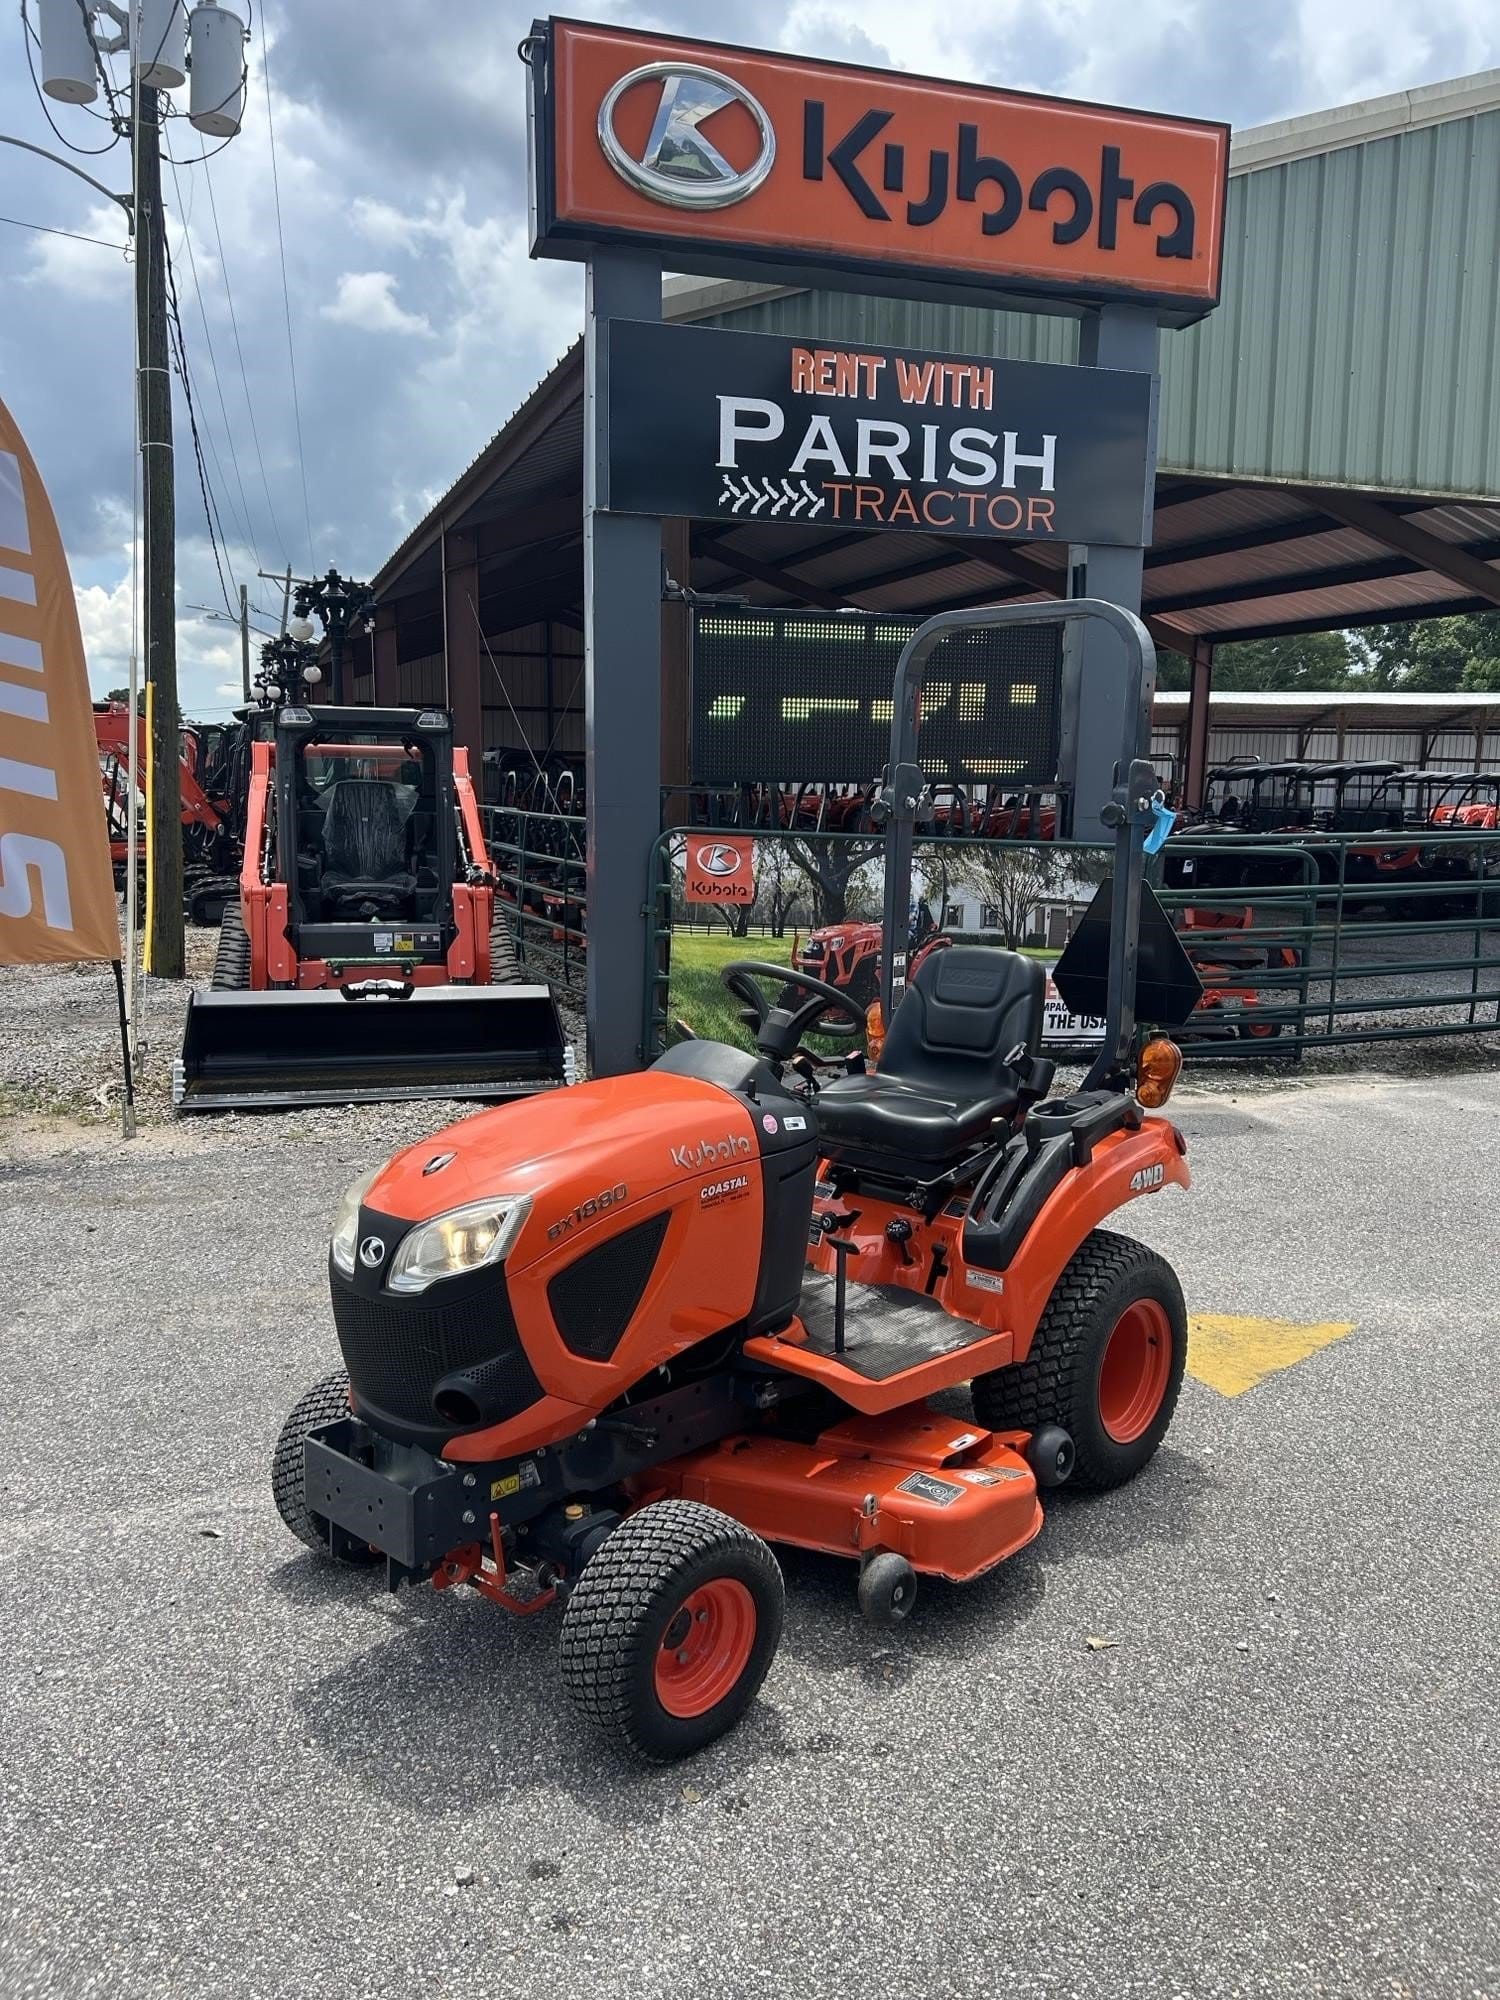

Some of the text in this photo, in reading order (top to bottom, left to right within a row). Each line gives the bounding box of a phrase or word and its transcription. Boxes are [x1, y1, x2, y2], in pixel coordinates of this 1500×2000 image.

[803, 99, 1196, 259] Kubota
[792, 347, 994, 411] RENT WITH
[715, 395, 1057, 491] PARISH
[820, 481, 1056, 532] TRACTOR
[691, 881, 748, 897] Kubota
[1048, 1014, 1077, 1029] THE
[670, 1134, 751, 1169] Kubota
[700, 1175, 748, 1199] COASTAL
[1130, 1163, 1164, 1190] 4WD
